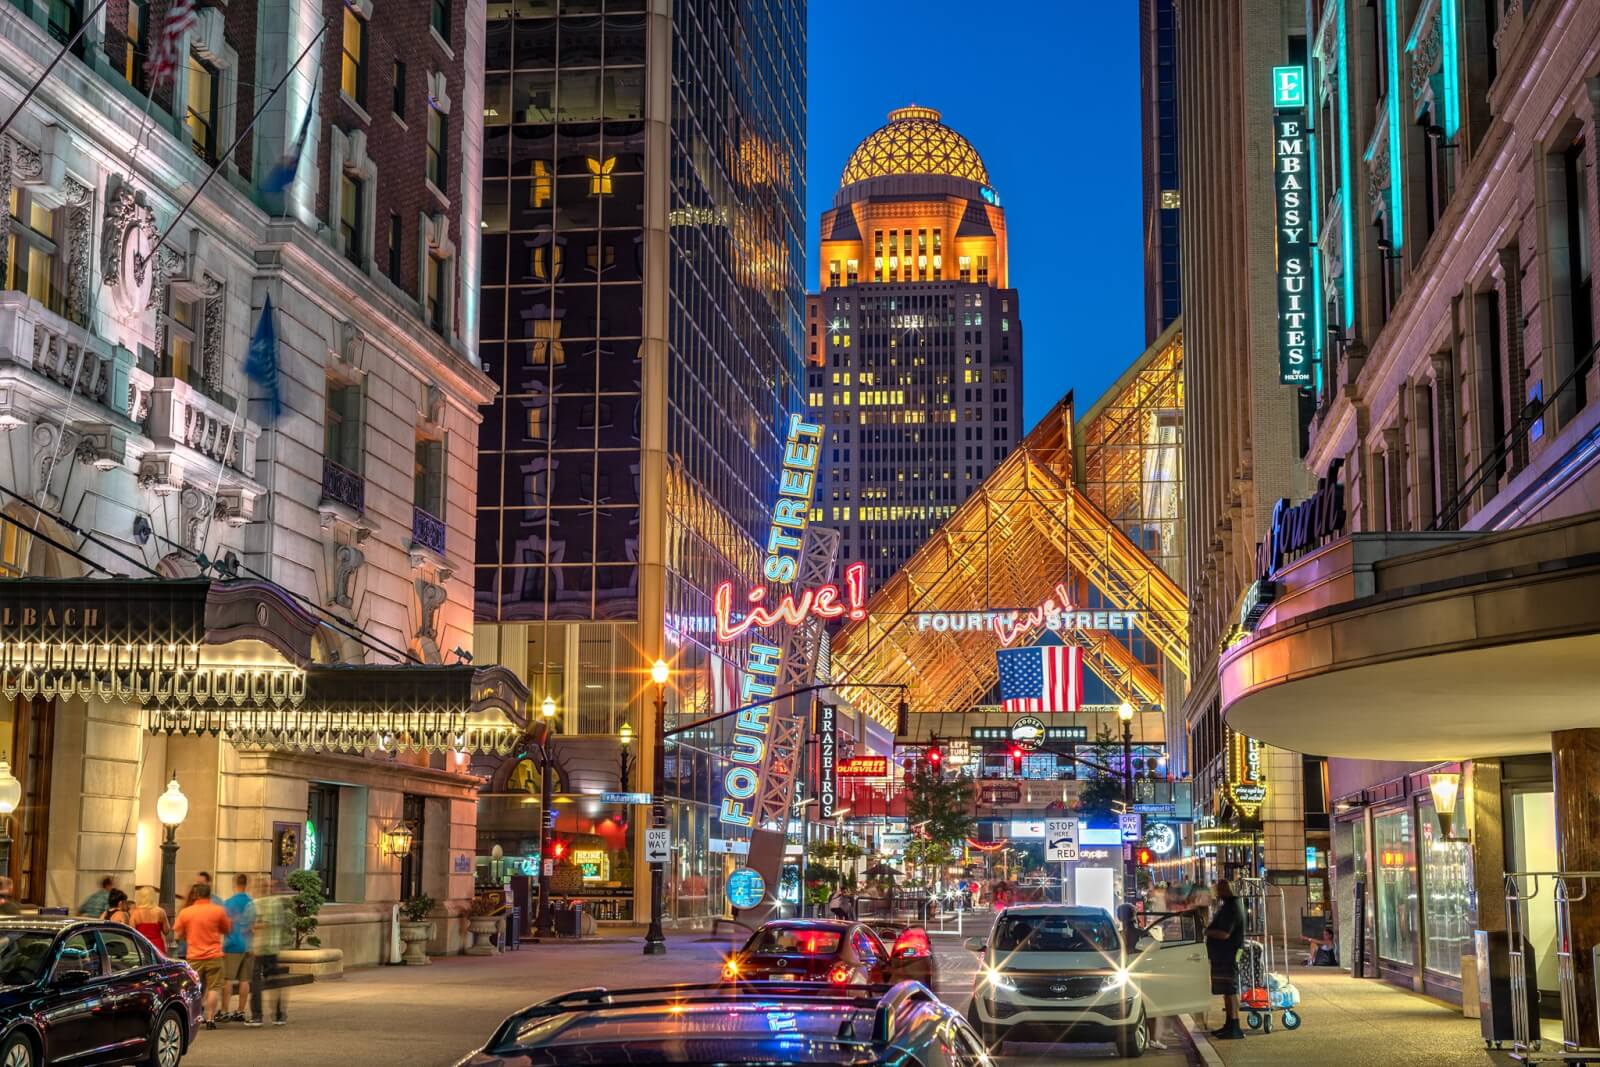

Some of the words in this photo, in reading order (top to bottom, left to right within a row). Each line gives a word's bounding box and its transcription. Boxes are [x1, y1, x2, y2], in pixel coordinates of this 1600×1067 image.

[1278, 121, 1304, 244] EMBASSY
[1283, 259, 1306, 364] SUITES
[714, 560, 867, 643] Live!
[720, 643, 782, 828] FOURTH
[764, 413, 826, 584] STREET
[918, 612, 1014, 632] FOURTH
[1045, 611, 1138, 631] STREET
[974, 729, 1007, 738] BEER
[1049, 729, 1086, 738] BRIDGE
[949, 740, 969, 748] LEFT
[821, 707, 834, 818] BRAZEIROS
[1049, 821, 1074, 831] STOP
[648, 831, 667, 840] ONE
[648, 840, 667, 849] WAY
[1057, 849, 1076, 858] RED
